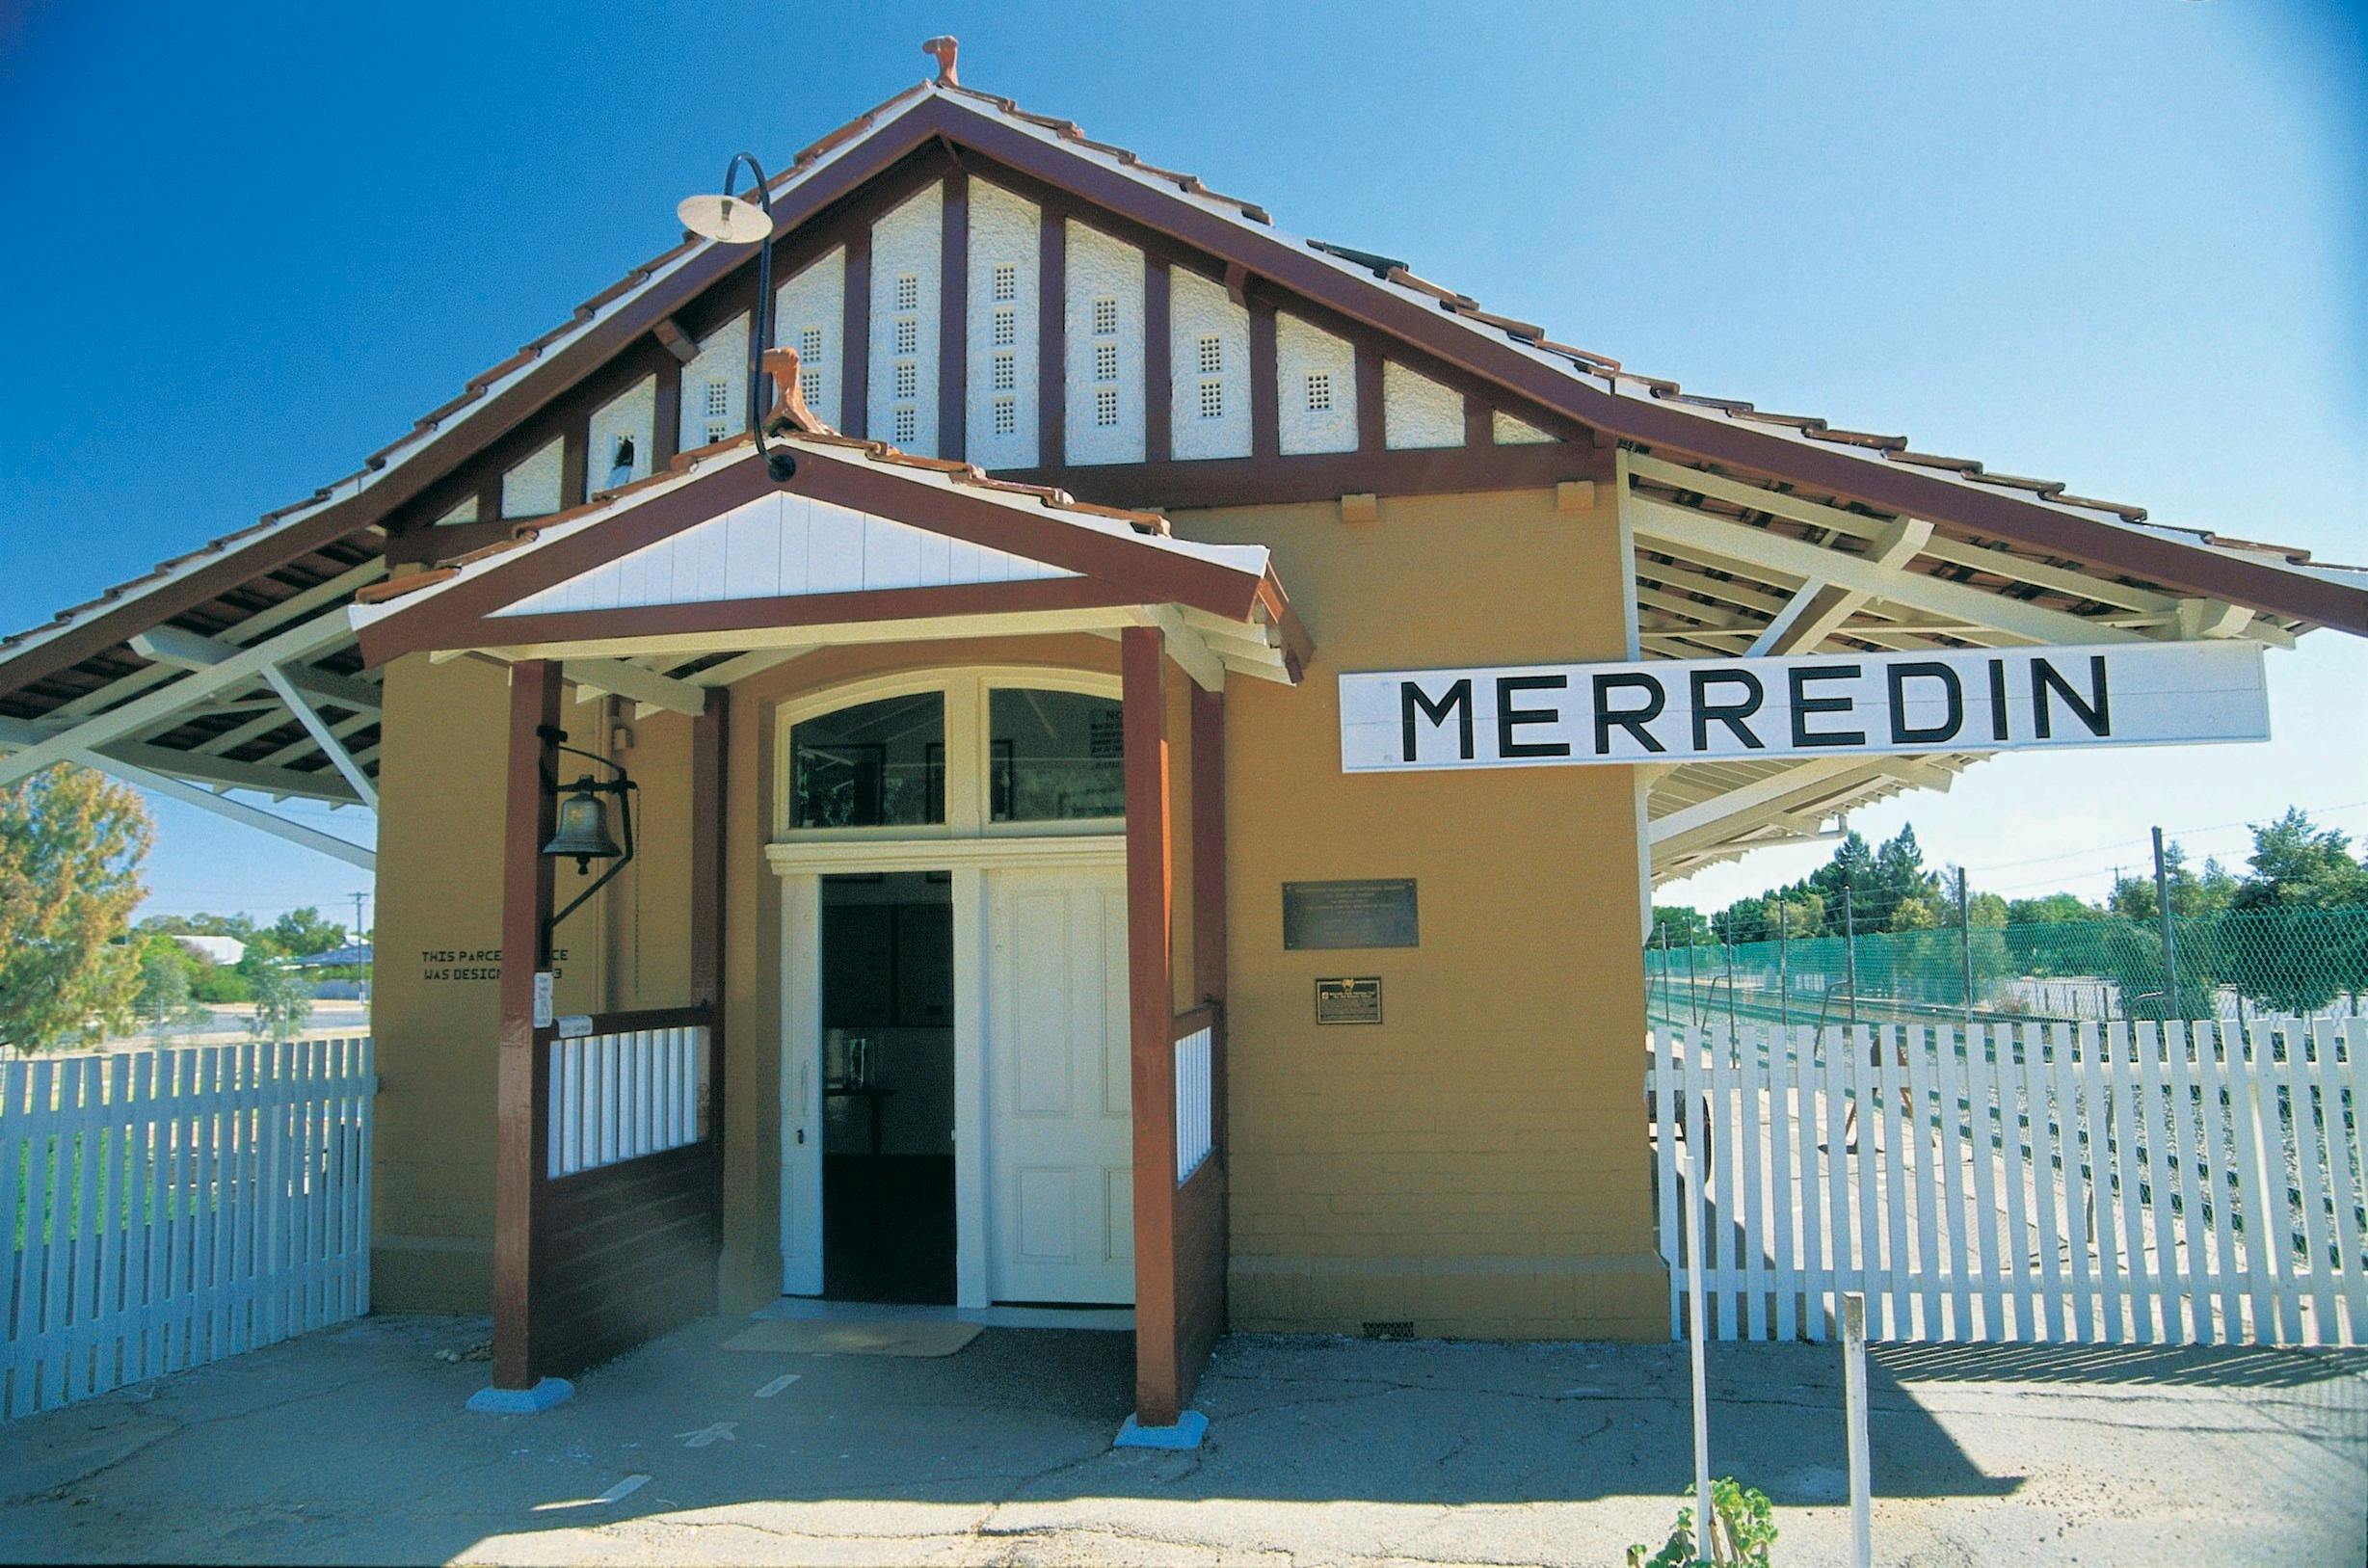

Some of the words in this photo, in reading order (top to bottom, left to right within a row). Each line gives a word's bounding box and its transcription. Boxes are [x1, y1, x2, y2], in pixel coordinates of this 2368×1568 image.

[1400, 655, 2111, 761] MERREDIN
[422, 951, 456, 962] THIS
[459, 950, 501, 962] PARCE
[424, 969, 449, 980] WAS
[454, 968, 502, 980] DESIG
